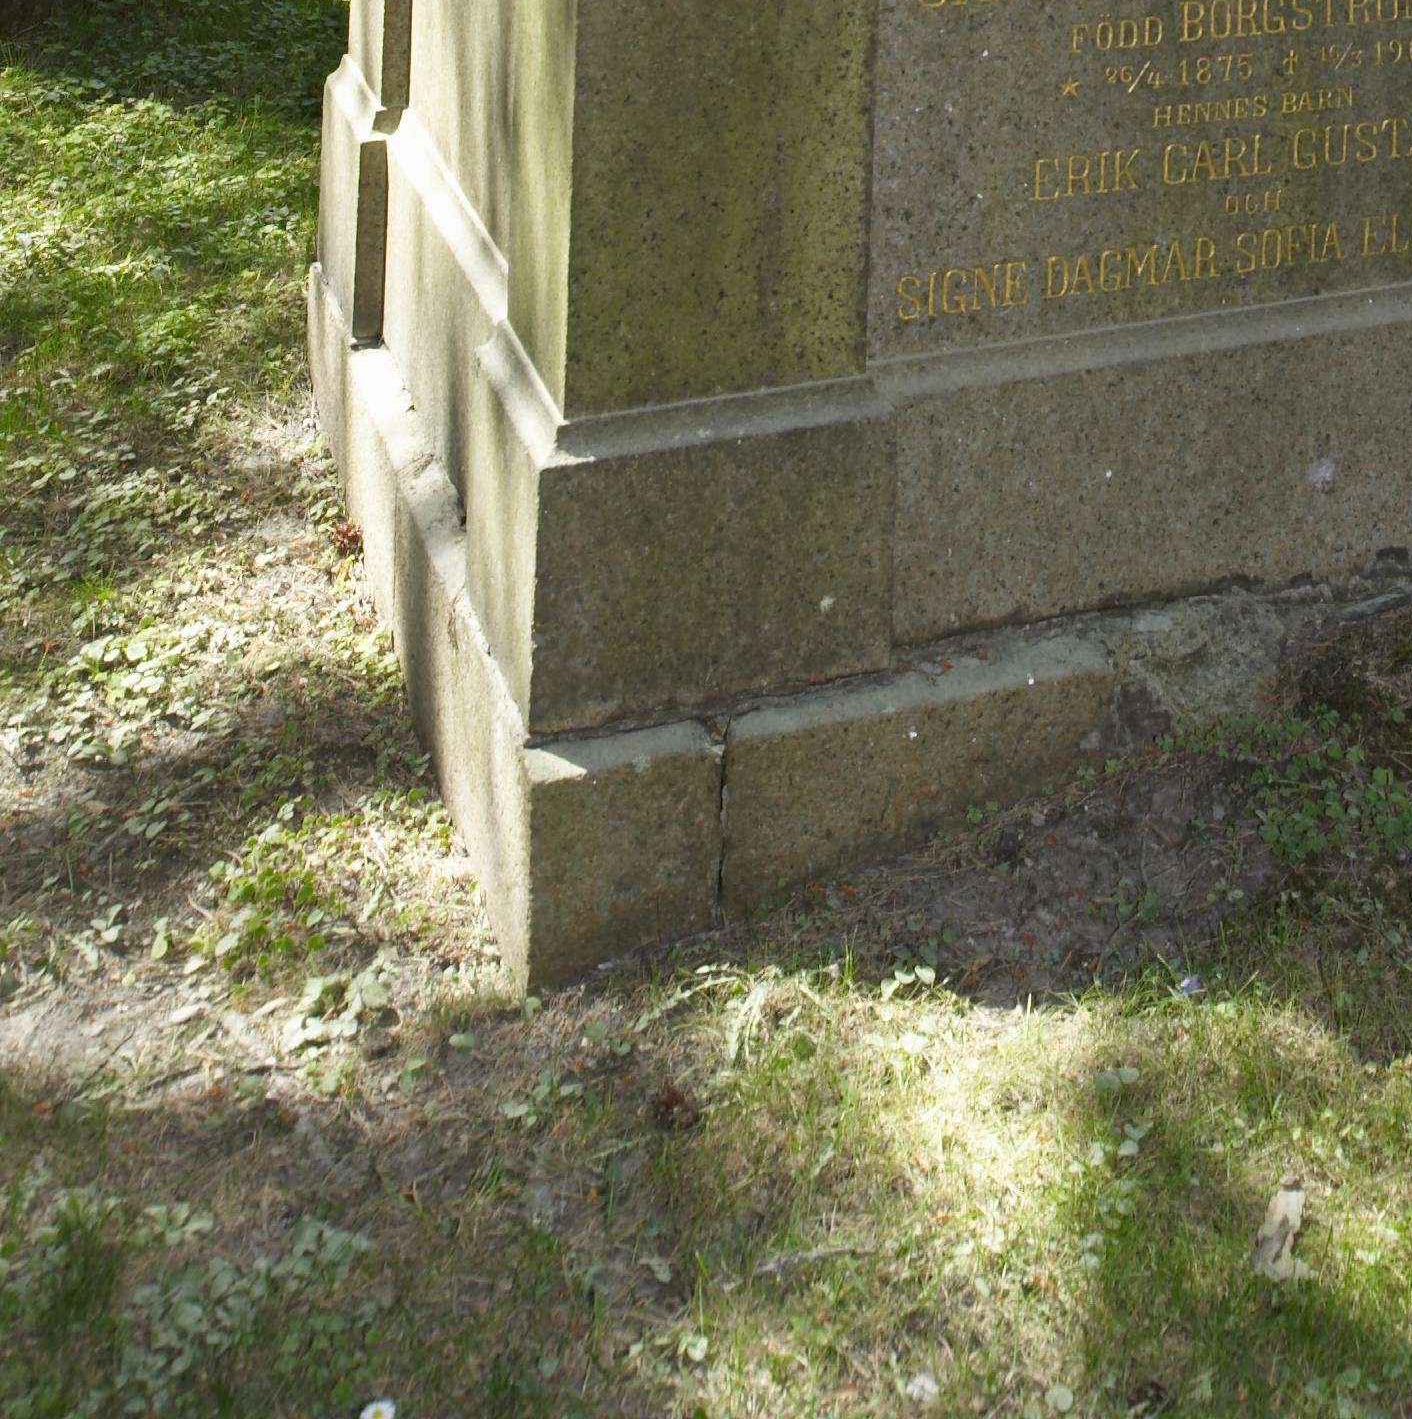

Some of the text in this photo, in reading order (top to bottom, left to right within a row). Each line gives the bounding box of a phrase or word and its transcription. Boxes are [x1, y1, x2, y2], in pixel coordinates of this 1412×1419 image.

[1070, 13, 1164, 54] FÖDD
[1178, 53, 1254, 86] 1875
[1151, 86, 1354, 129] HENNES BARN
[1031, 148, 1141, 202] ERIK
[1162, 132, 1273, 186] CARL
[1224, 187, 1283, 215] OCH
[895, 261, 1029, 321] SIGNE
[1041, 236, 1221, 300] DAGMAR
[1234, 220, 1346, 274] SOFIA
